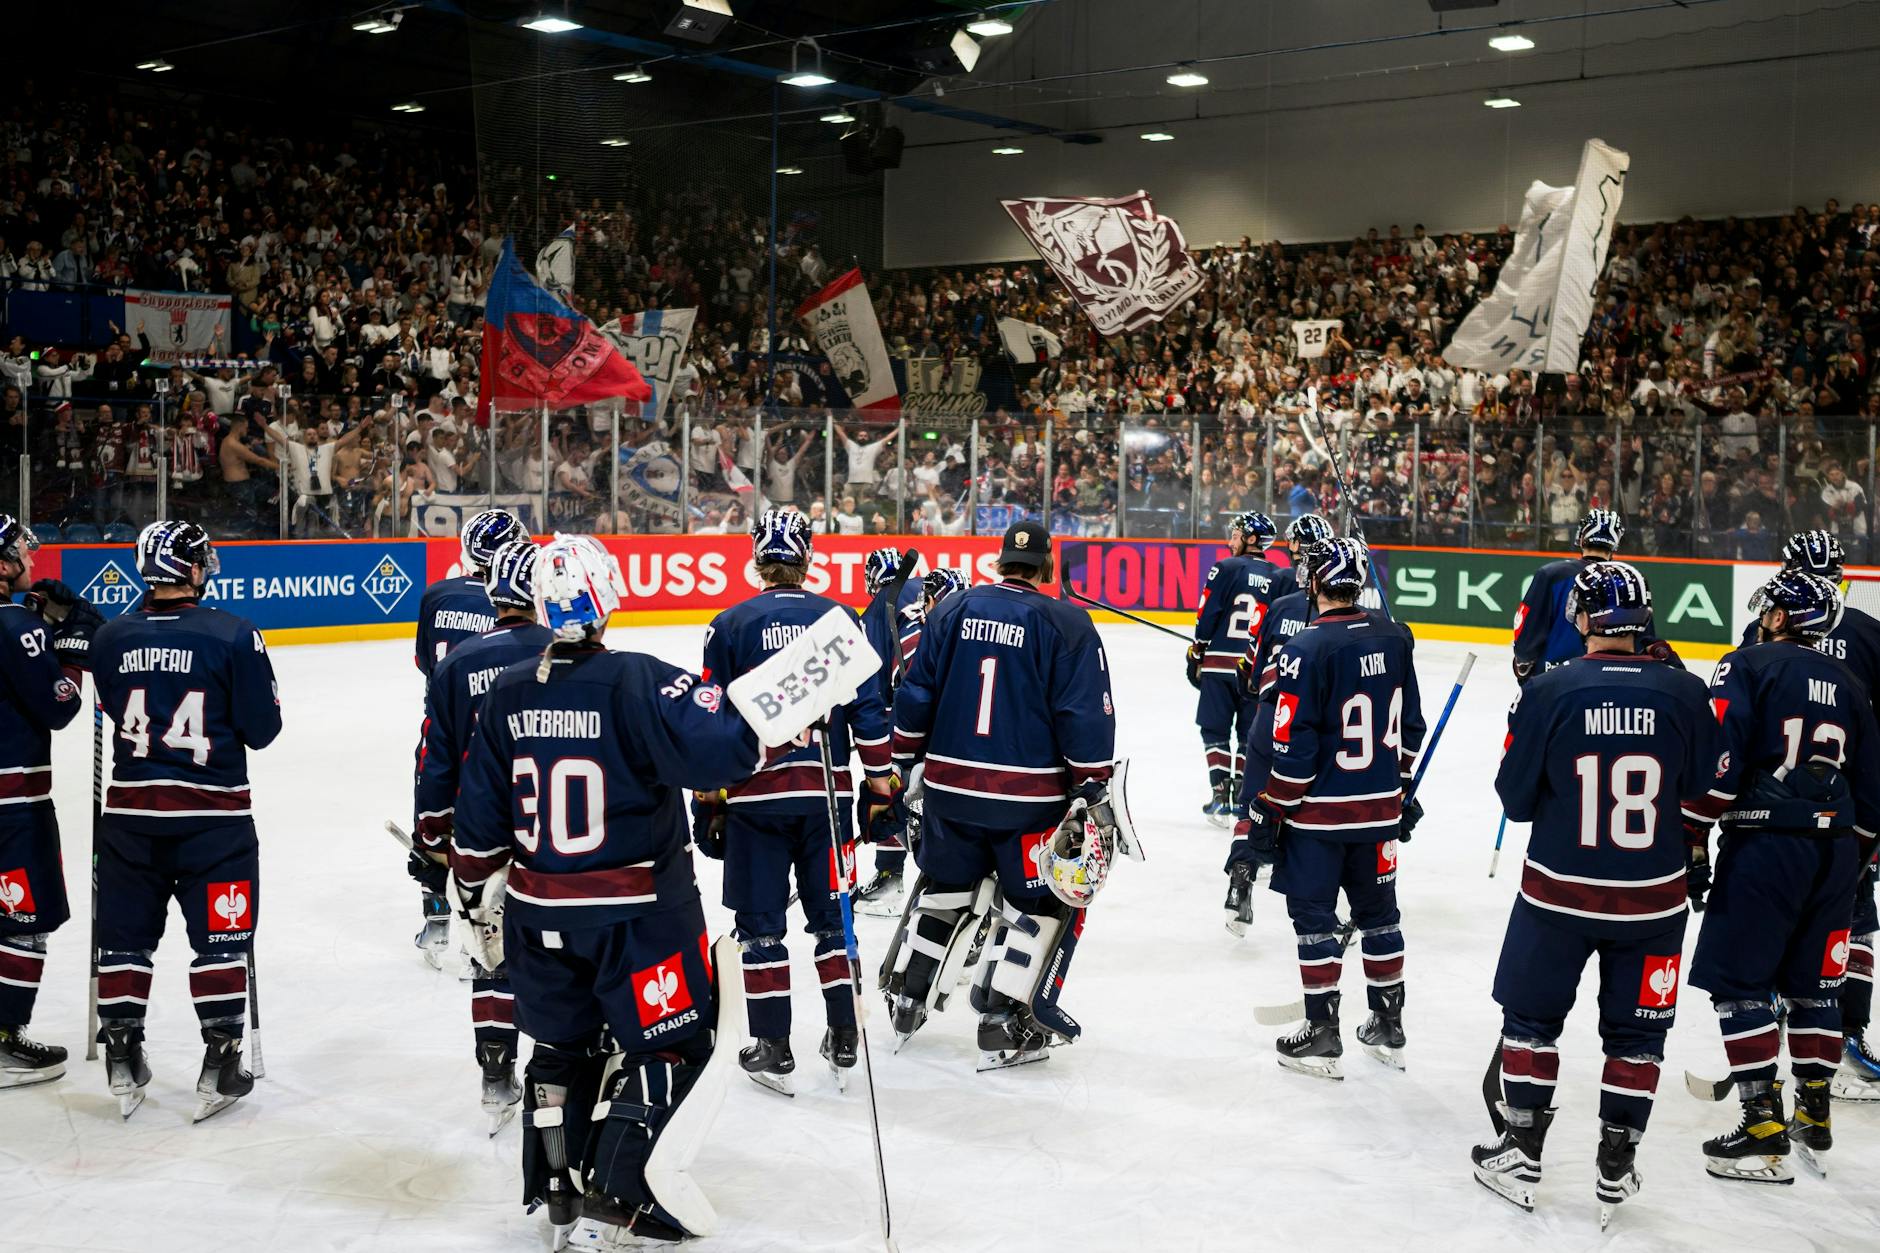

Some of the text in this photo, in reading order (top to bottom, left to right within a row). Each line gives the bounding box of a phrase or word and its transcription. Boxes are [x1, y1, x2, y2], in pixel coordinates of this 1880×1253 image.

[1148, 279, 1187, 306] BERLIN
[1304, 327, 1322, 344] 22
[759, 548, 796, 557] STADLER
[202, 575, 355, 601] ATE BANKING
[371, 577, 405, 594] LGT
[606, 552, 728, 598] AUSS
[1069, 544, 1200, 610] JOIN
[91, 585, 132, 605] LGT
[1395, 566, 1725, 628] SKA
[20, 627, 47, 658] 97
[762, 621, 813, 651] HÖRD
[961, 617, 1025, 649] STETTMER
[1279, 653, 1301, 680] 94
[1359, 652, 1387, 678] KIRK
[1711, 662, 1732, 687] 12
[976, 656, 997, 736] 1
[1807, 678, 1838, 708] MIK
[119, 689, 211, 767] 44
[1335, 687, 1403, 771] 94
[1584, 701, 1656, 736] MÜLLER
[512, 756, 606, 855] 30
[1576, 754, 1662, 850] 18
[1041, 947, 1065, 1000] WARRIOR
[643, 1009, 699, 1040] STRAUSS
[1634, 1008, 1675, 1020] STRAUSS
[1486, 1150, 1519, 1170] CCM
